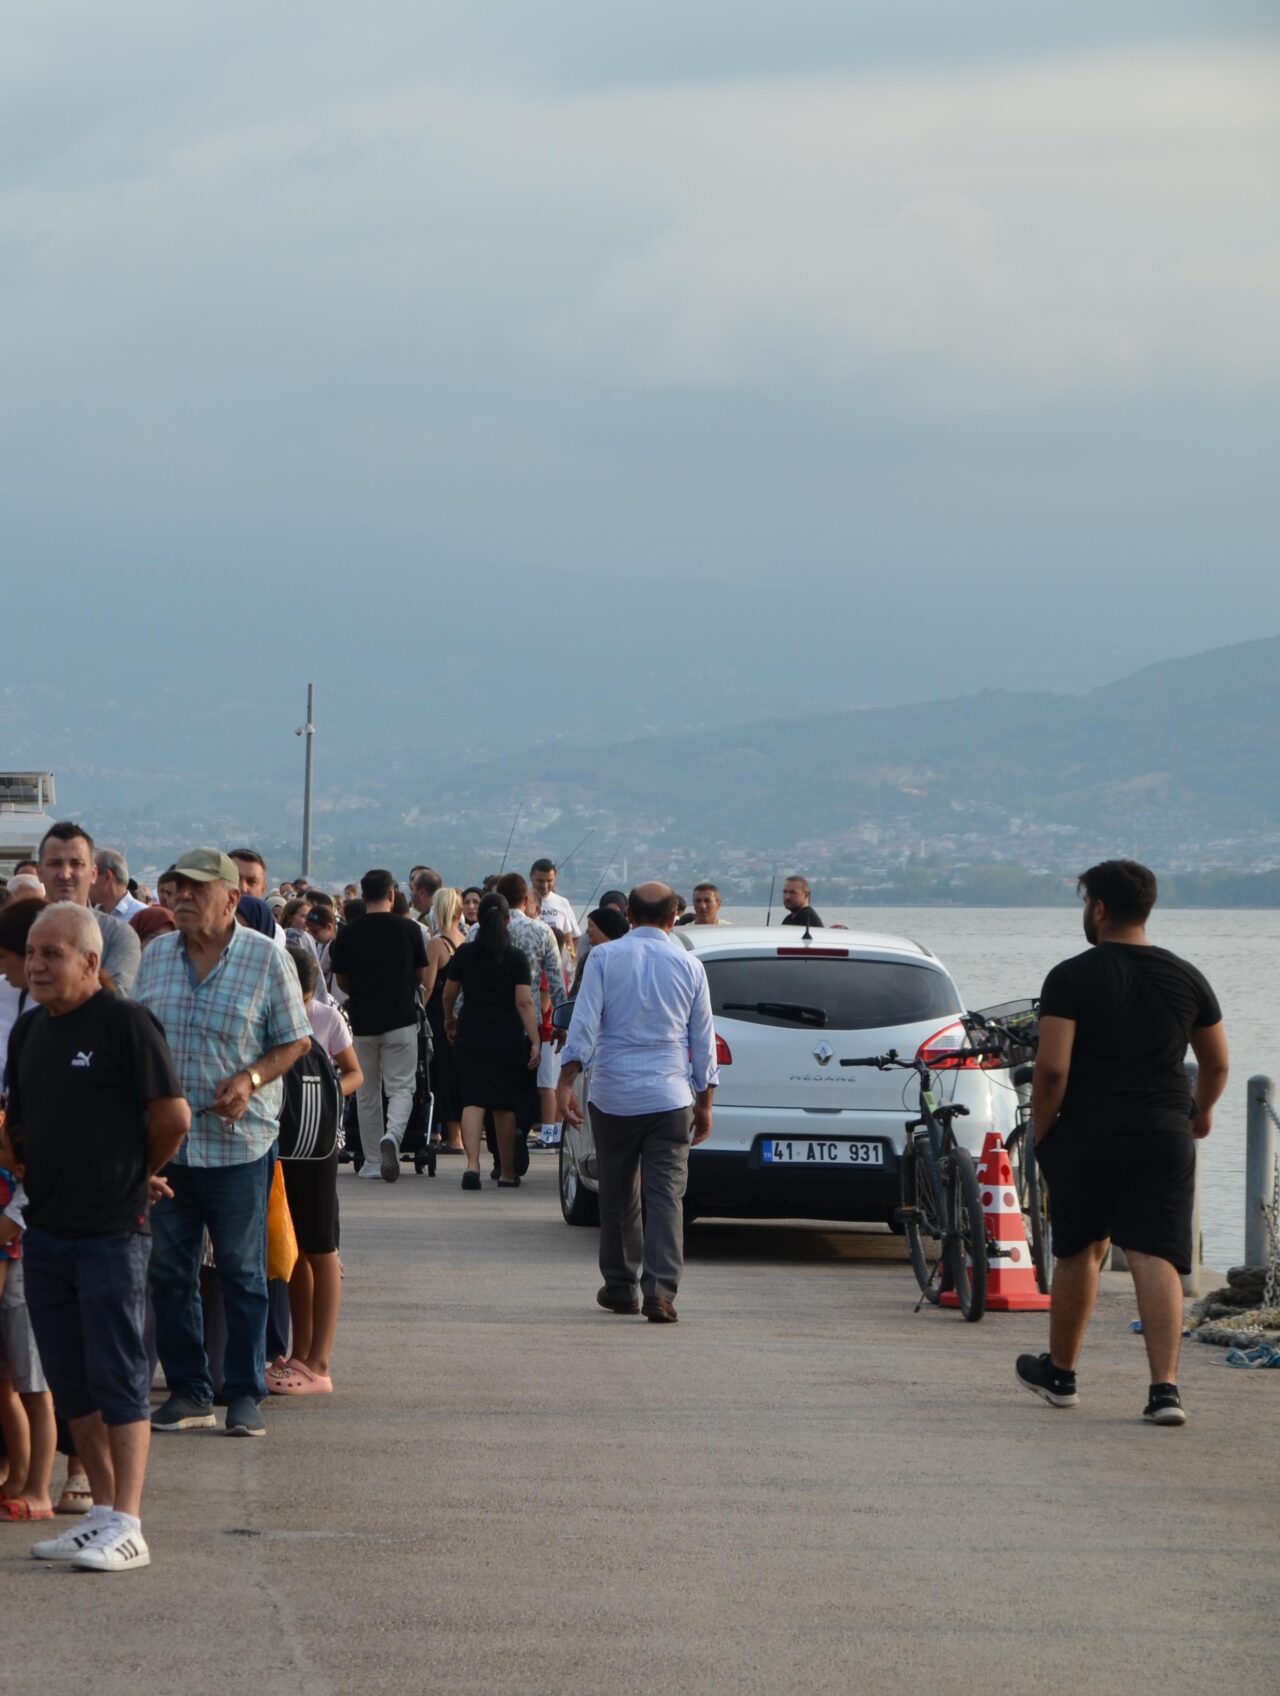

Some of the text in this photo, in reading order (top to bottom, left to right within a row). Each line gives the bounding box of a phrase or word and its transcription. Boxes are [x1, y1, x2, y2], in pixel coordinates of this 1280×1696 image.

[773, 1142, 880, 1163] 41 ATC 931
